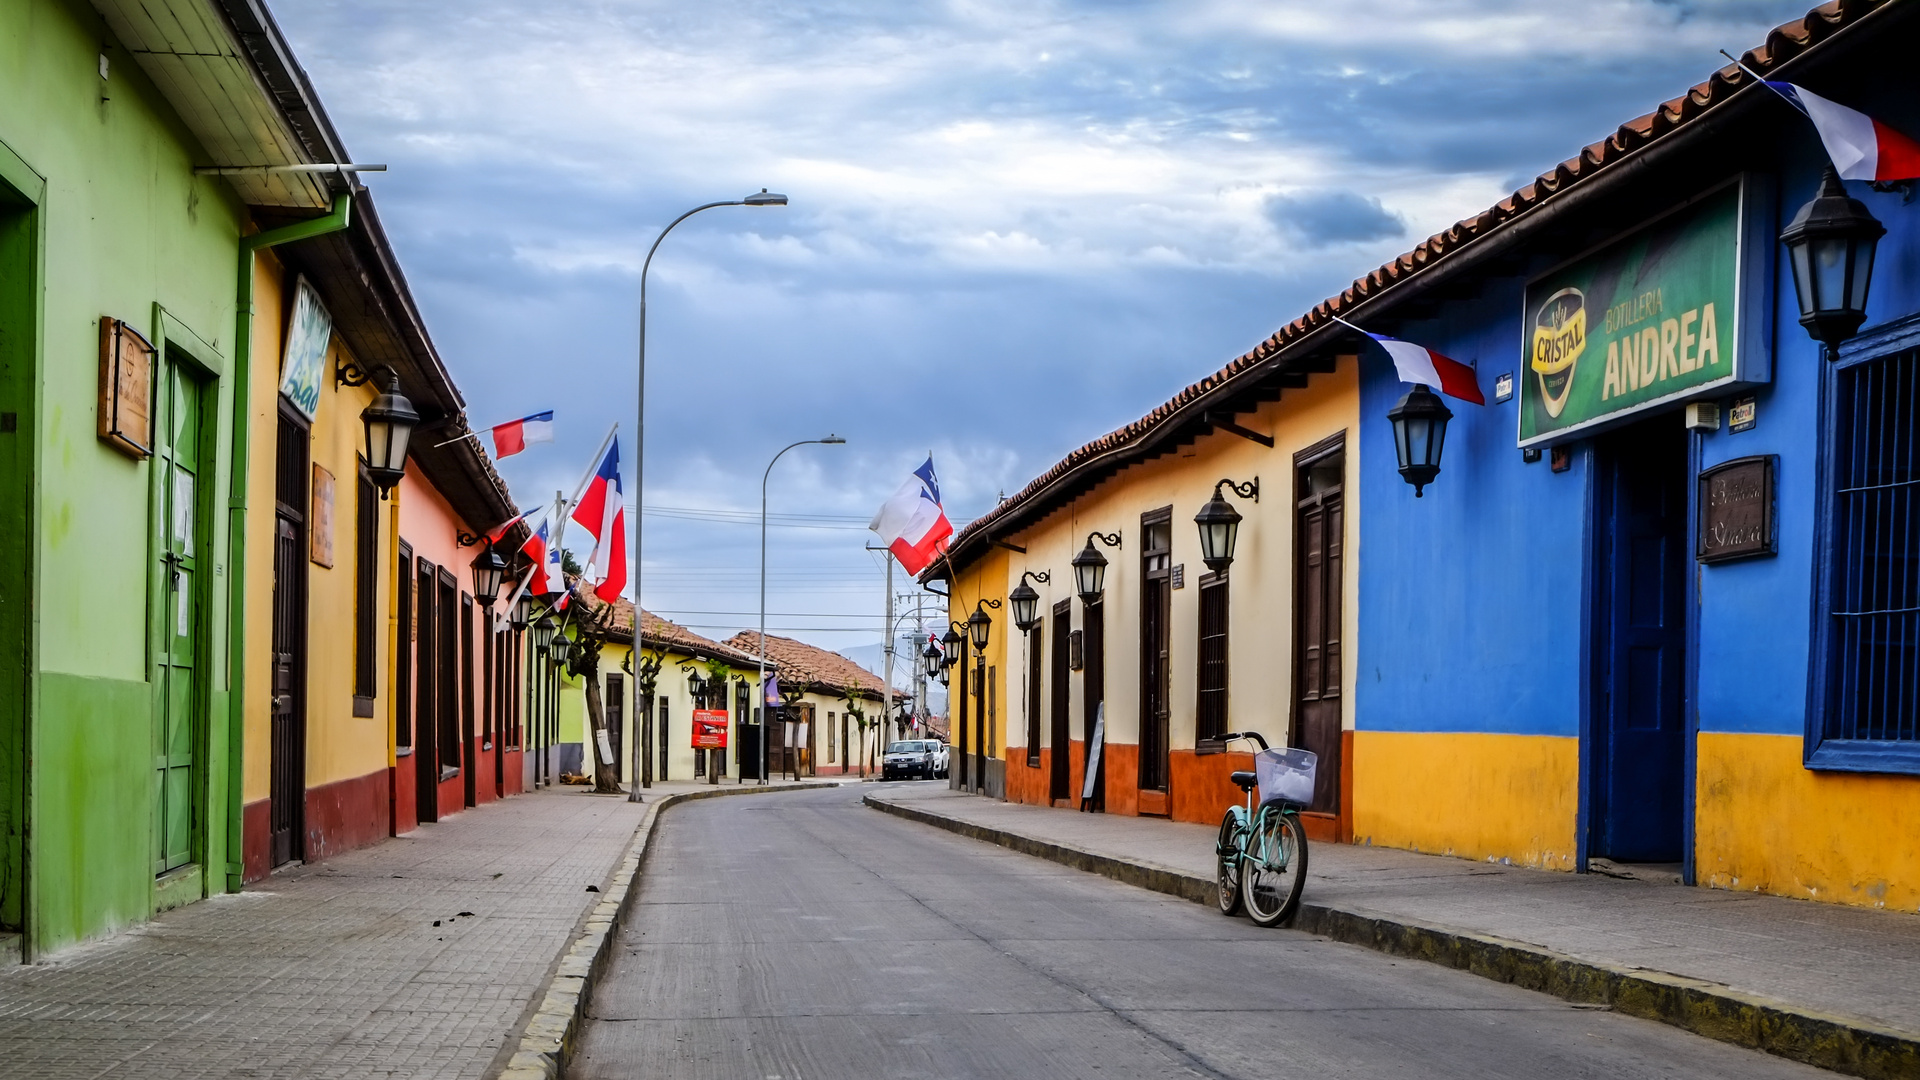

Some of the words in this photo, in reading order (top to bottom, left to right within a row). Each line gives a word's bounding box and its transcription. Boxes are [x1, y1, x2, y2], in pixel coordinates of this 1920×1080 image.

[1605, 288, 1663, 335] BOTILLERIA
[1537, 323, 1583, 363] CRISTAL
[1601, 302, 1719, 401] ANDREA
[1549, 377, 1565, 388] CERVEZA
